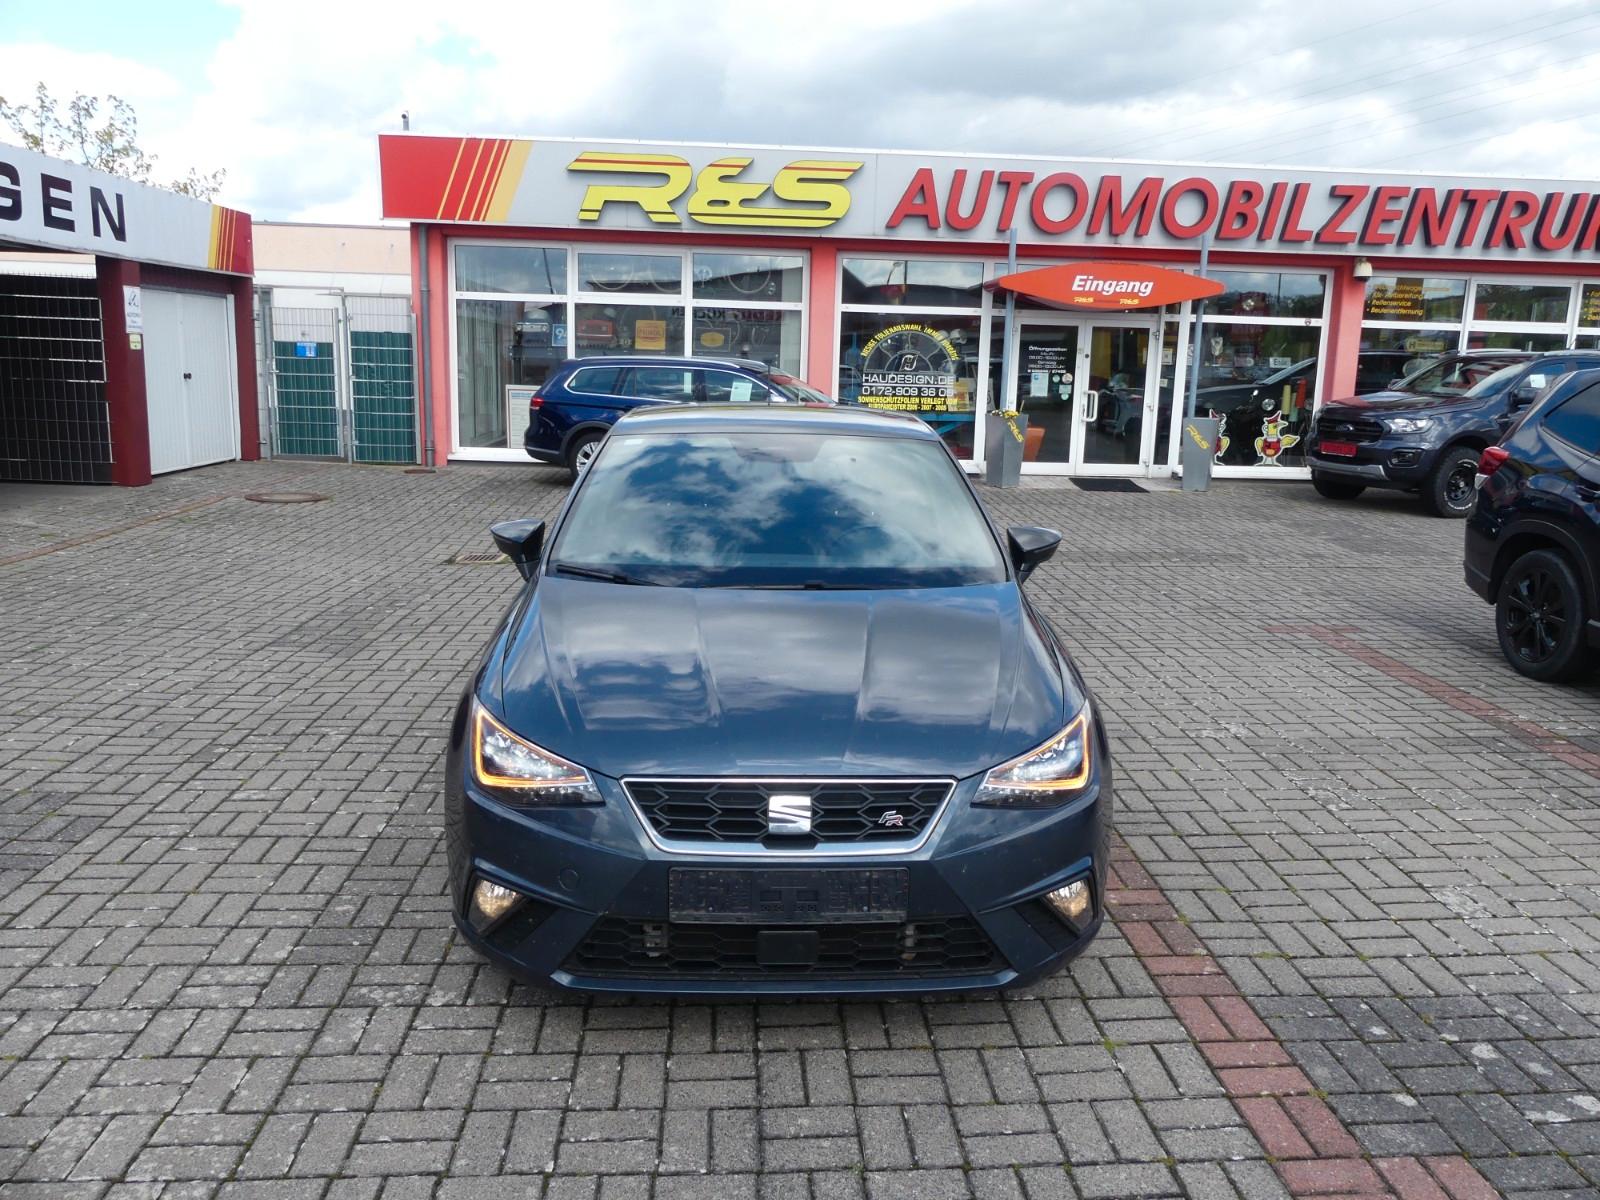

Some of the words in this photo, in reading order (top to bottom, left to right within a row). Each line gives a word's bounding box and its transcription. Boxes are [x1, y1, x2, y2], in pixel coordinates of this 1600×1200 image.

[566, 151, 865, 228] R&S
[1071, 275, 1154, 297] Eingang
[862, 374, 955, 384] HAUDESIGN.DE
[862, 386, 918, 396] 0172-909
[877, 810, 904, 827] FR
